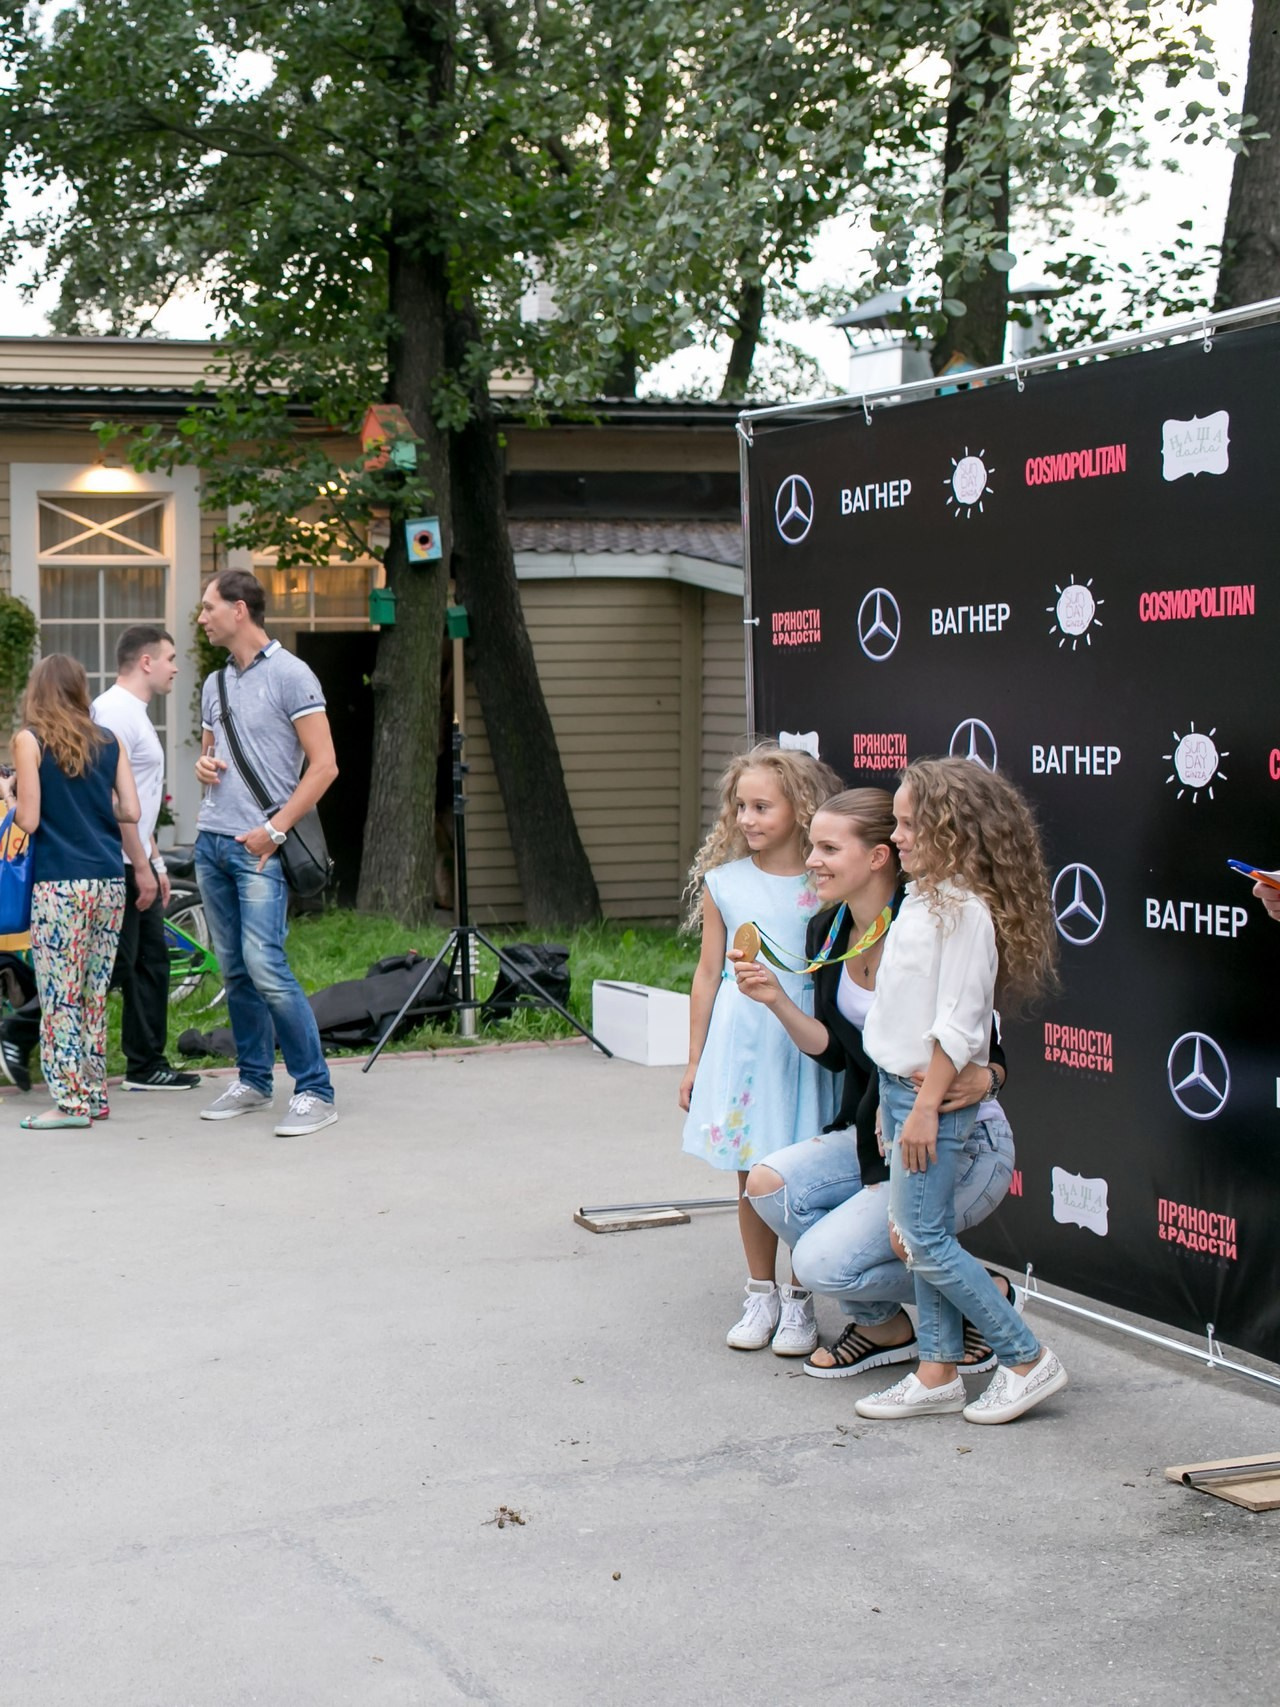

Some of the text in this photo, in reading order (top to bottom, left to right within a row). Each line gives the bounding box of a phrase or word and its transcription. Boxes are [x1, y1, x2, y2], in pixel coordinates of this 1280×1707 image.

[1025, 444, 1126, 486] COSMOPOLITAN
[841, 479, 912, 515] ВАГНЕР
[931, 603, 1011, 635] ВАГНЕР
[1139, 585, 1255, 622] COSMOPOLITAN
[772, 608, 820, 632] ПРЯНОСТИ
[772, 630, 821, 646] &РАДОСТИ
[853, 733, 907, 754] ПРЯНОСТИ
[853, 755, 908, 770] &РАДОСТИ
[1031, 745, 1121, 776] ВАГНЕР
[1185, 754, 1208, 769] DAY
[1146, 898, 1248, 938] ВАГНЕР
[1044, 1022, 1112, 1057] ПРЯНОСТИ
[1044, 1046, 1113, 1073] &РАДОСТИ
[1158, 1198, 1236, 1243] ПРЯНОСТИ
[1158, 1223, 1237, 1260] &РАДОСТИ
